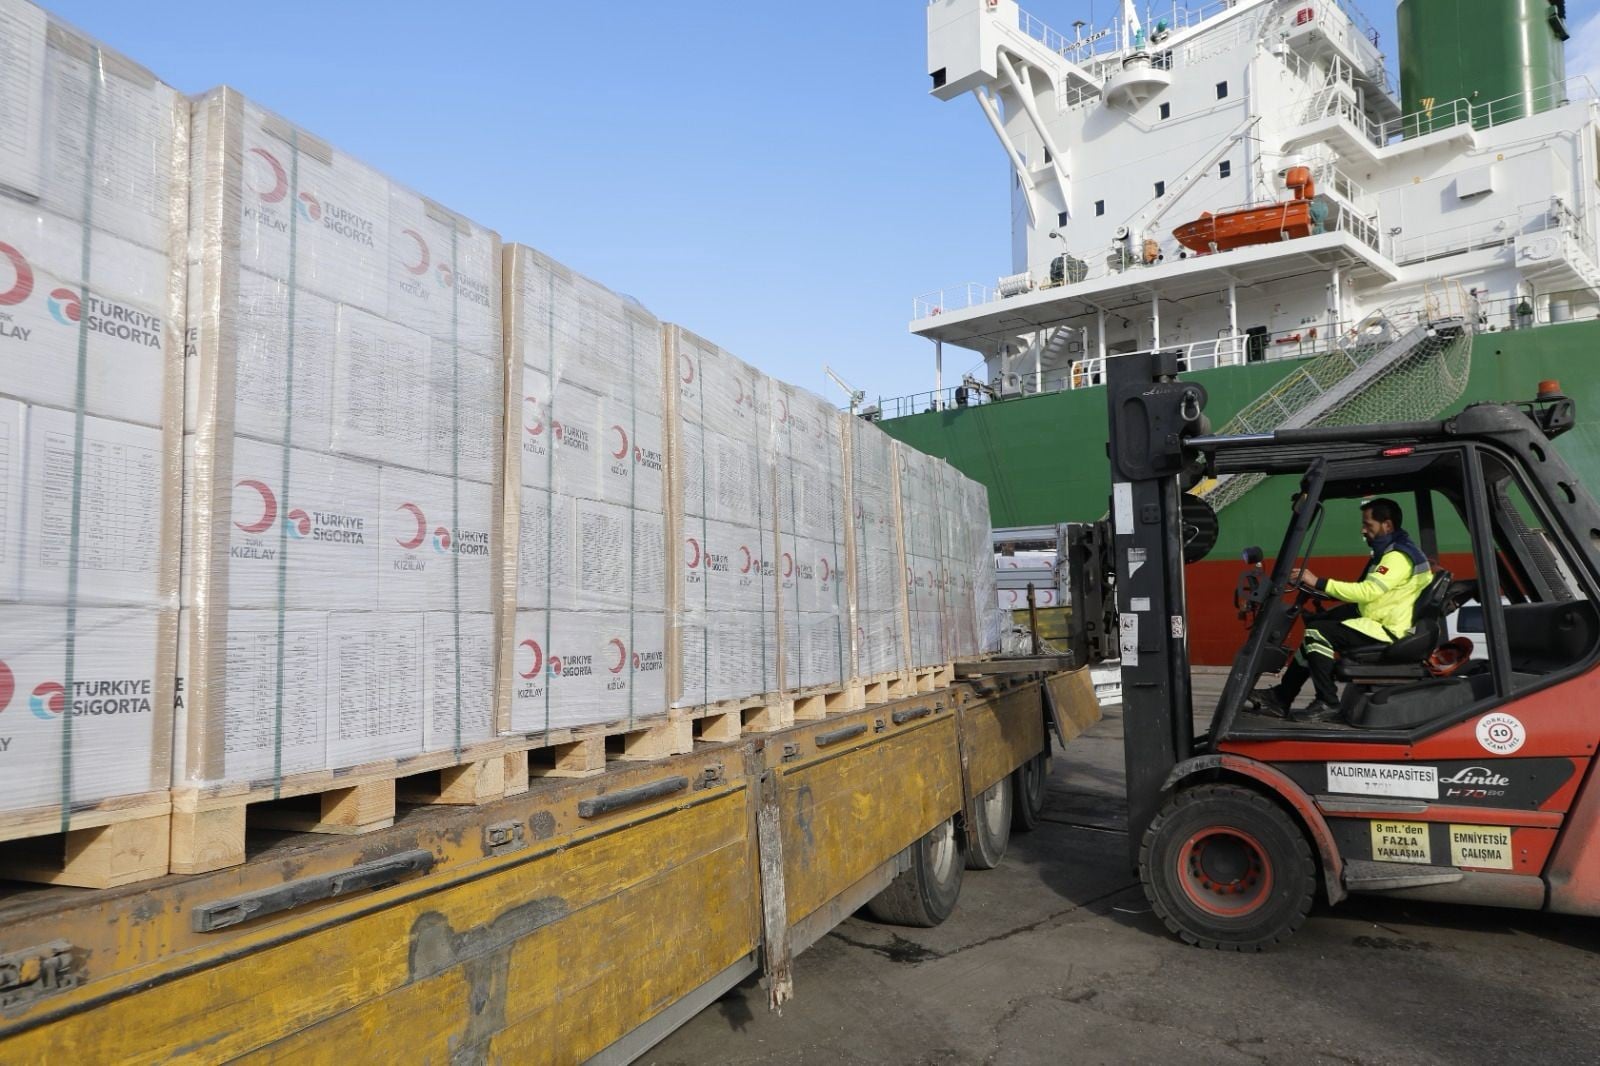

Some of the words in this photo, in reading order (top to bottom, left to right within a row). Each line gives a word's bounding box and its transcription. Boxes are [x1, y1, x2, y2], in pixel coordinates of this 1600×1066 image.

[323, 216, 374, 248] SİGORTA
[89, 297, 161, 333] TÜRKİYE
[0, 322, 32, 342] LAY
[88, 316, 161, 350] SİGORTA
[312, 528, 365, 545] SİGORTA
[73, 679, 152, 697] TÜRKİYE
[71, 698, 152, 717] SİGORTA
[1494, 729, 1508, 737] 10
[1330, 766, 1378, 779] KALDIRMA
[1379, 768, 1435, 782] KAPASİTESİ
[1440, 766, 1510, 786] Linde
[1376, 823, 1383, 833] 8
[1383, 836, 1418, 847] FAZLA
[1454, 832, 1508, 846] EMNİYETSİZ
[1377, 848, 1426, 859] YAKLAŞMA
[1461, 847, 1502, 862] ÇALIŞMA
